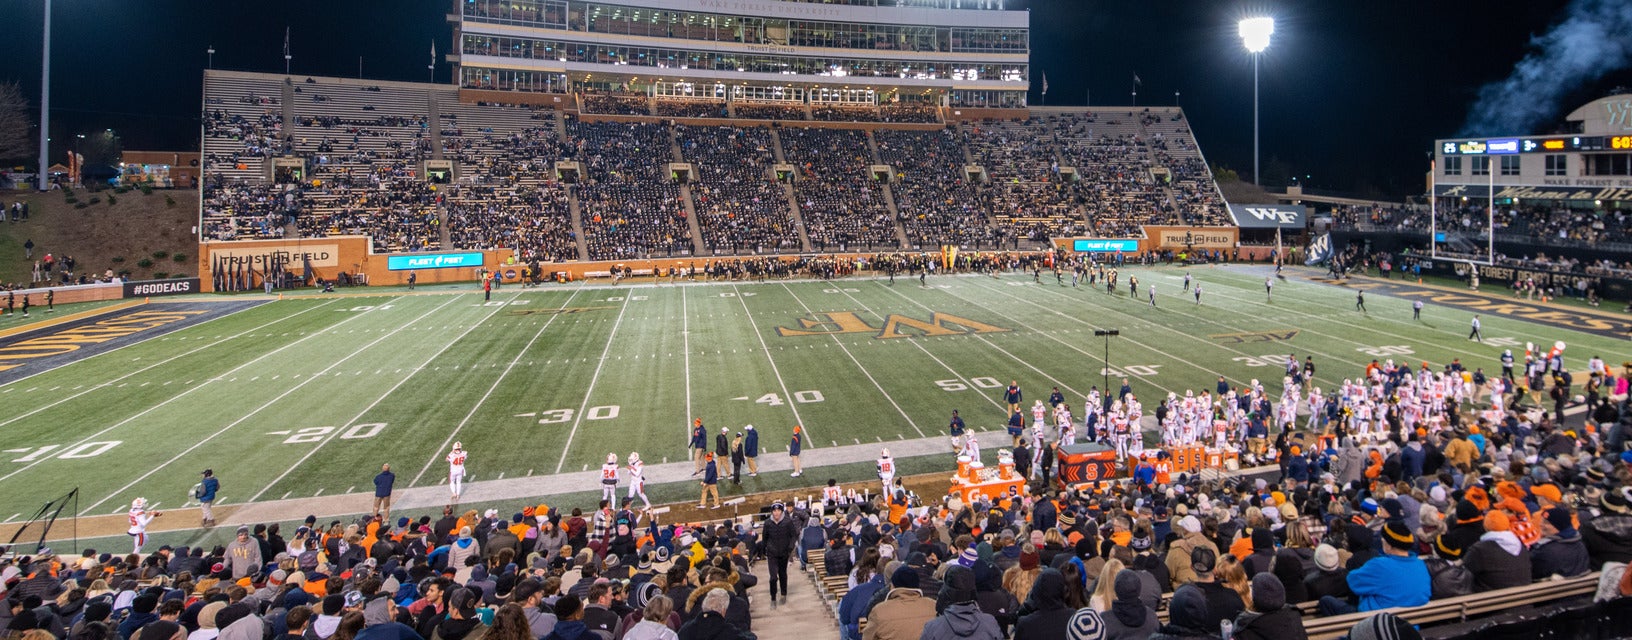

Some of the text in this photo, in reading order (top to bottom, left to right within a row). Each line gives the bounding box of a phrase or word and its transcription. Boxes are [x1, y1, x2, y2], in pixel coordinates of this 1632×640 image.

[1577, 179, 1612, 187] FOREST
[1245, 207, 1298, 224] WF
[293, 251, 330, 262] FIELD
[408, 256, 464, 266] FLEET FEET
[1481, 266, 1514, 280] FOREST
[134, 282, 190, 295] #GODEACS
[935, 376, 1003, 391] 50
[755, 390, 825, 406] 40
[538, 405, 620, 424] 30
[283, 423, 388, 444] 20
[11, 440, 124, 462] 10
[1178, 455, 1184, 464] S
[1086, 463, 1098, 480] S
[1156, 463, 1168, 473] 44
[1009, 485, 1017, 496] S
